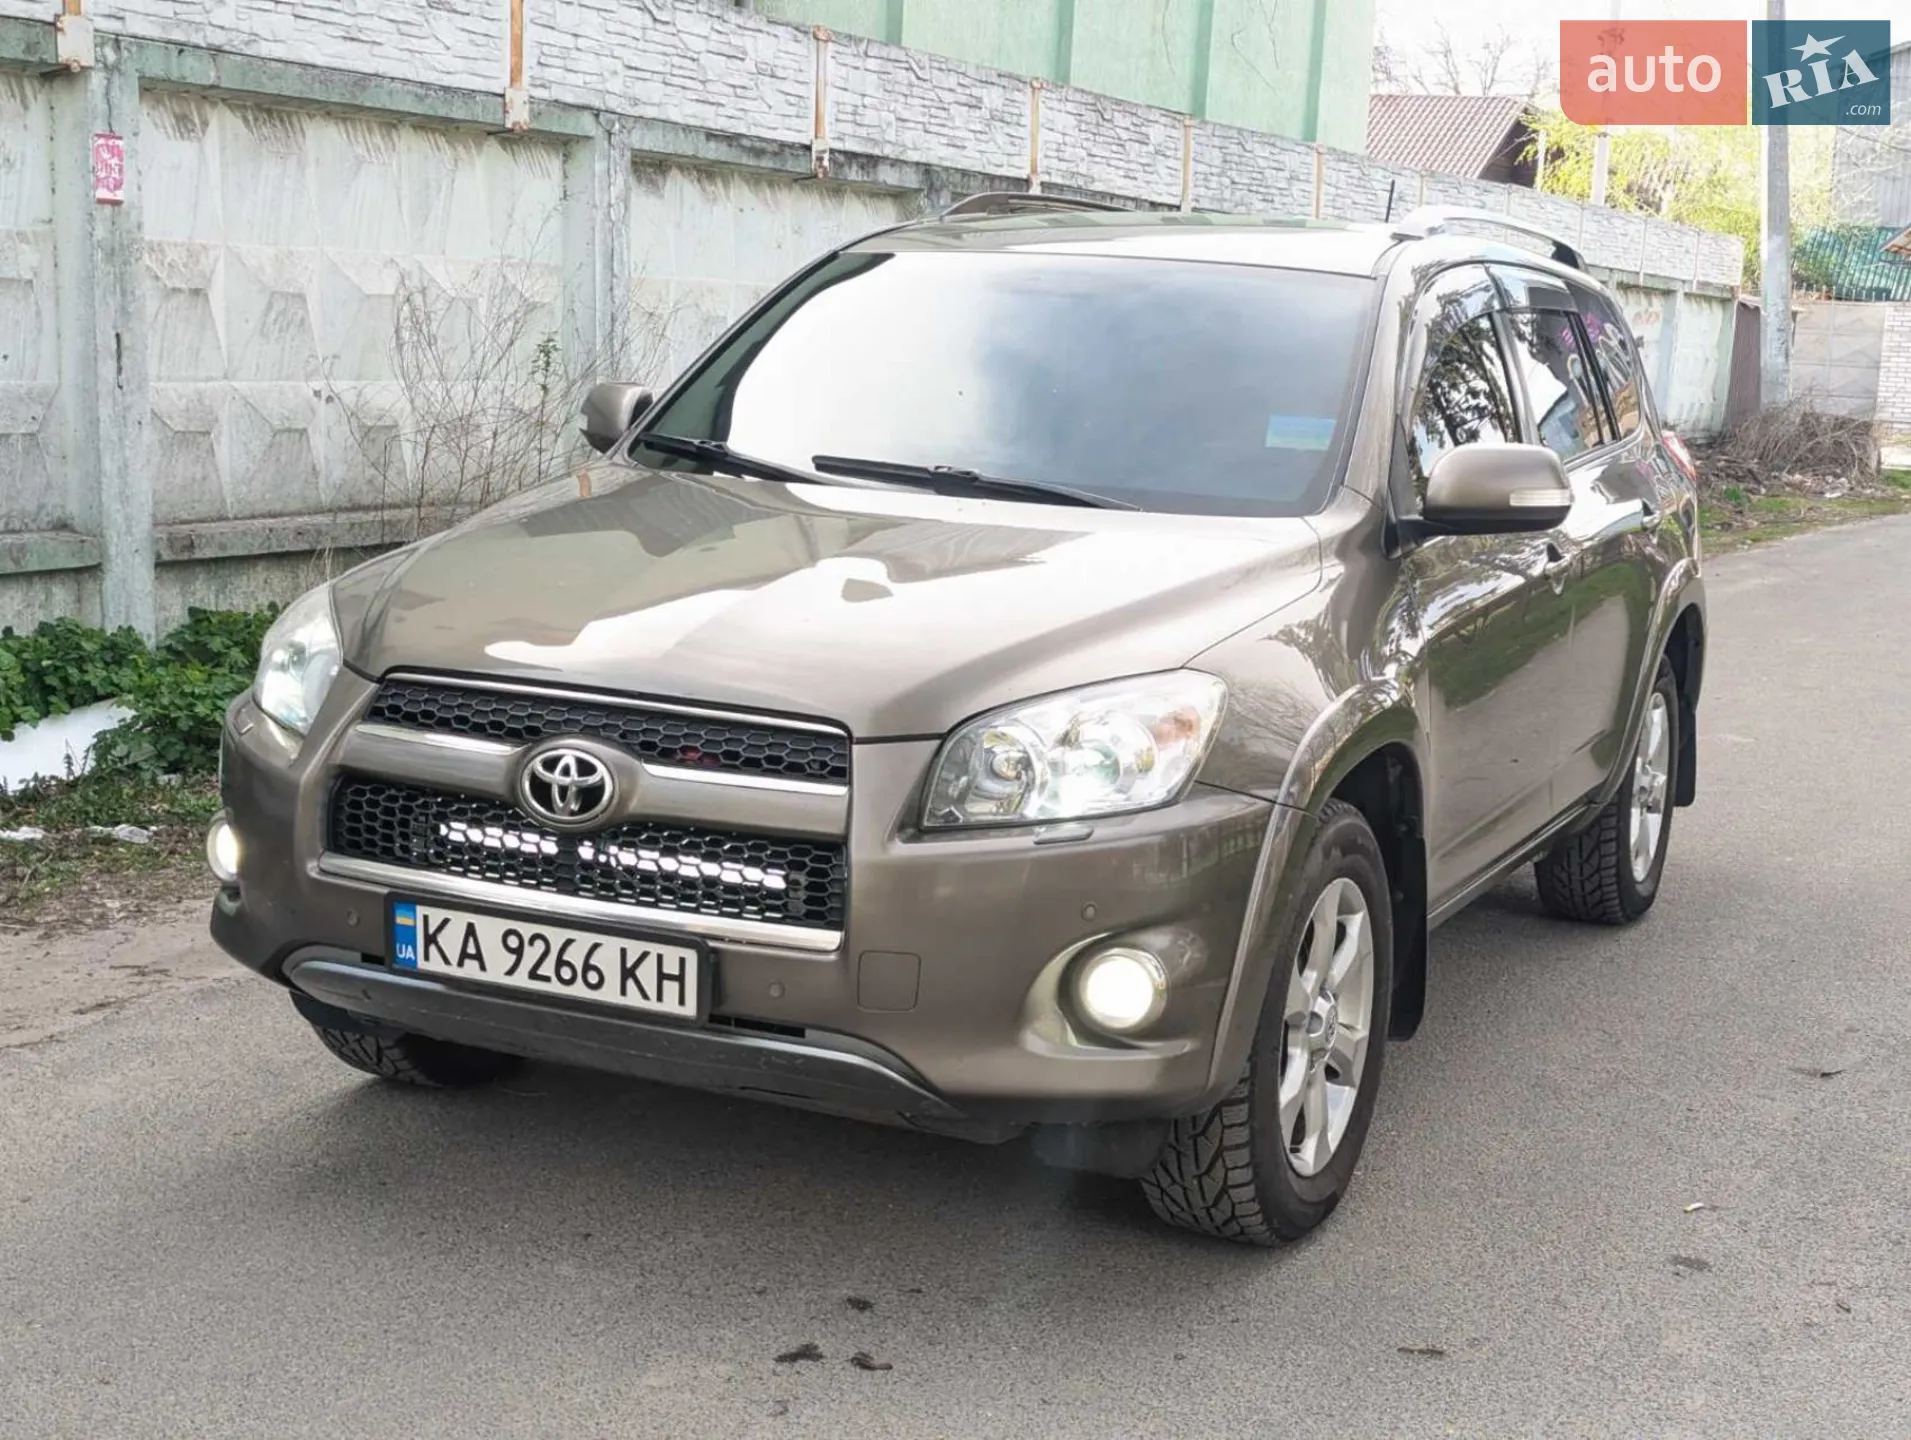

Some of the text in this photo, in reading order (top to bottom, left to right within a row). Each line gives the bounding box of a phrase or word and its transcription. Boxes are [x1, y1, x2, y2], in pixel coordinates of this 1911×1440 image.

[395, 942, 416, 961] UA
[422, 914, 687, 1007] KA 9266 KH
